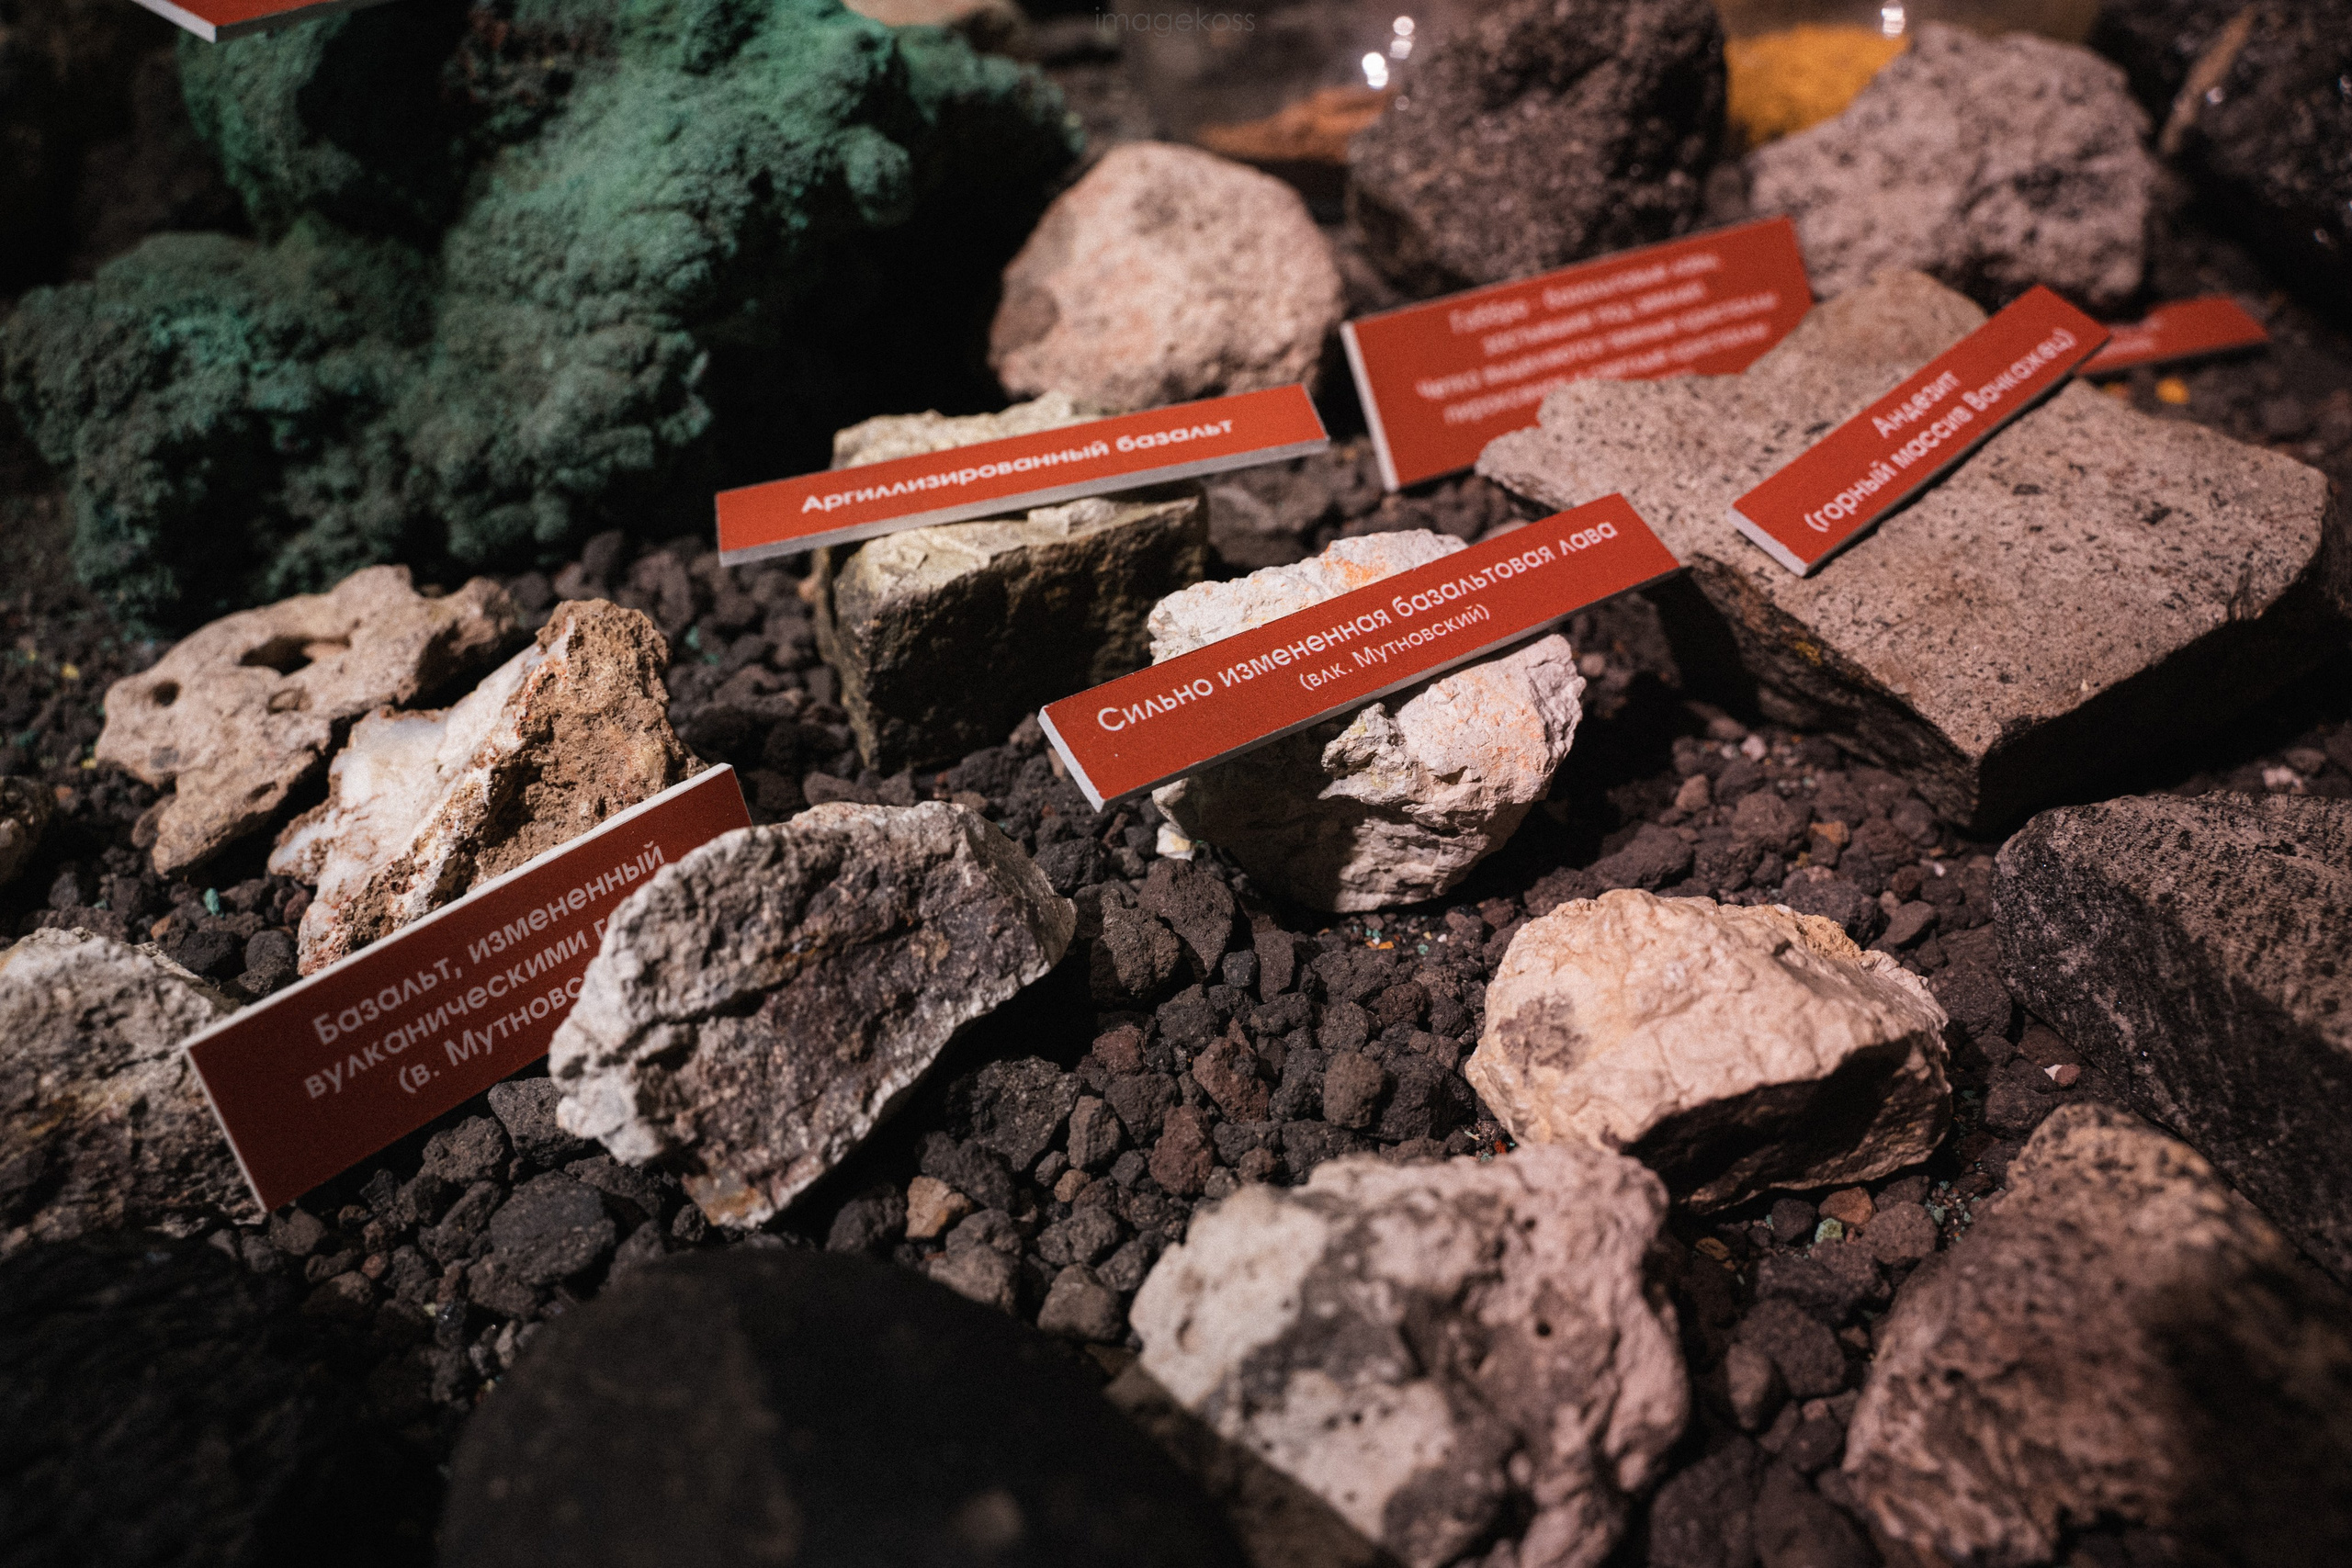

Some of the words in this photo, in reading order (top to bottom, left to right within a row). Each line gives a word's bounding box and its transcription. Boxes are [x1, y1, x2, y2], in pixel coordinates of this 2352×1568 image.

[1871, 370, 1959, 438] Андезит
[801, 440, 1110, 513] Аргиллизированный
[1115, 420, 1232, 452] базальт
[1804, 460, 1897, 533] (горный
[1890, 406, 1973, 468] массив
[1097, 678, 1214, 732] Сильно
[1217, 608, 1392, 688] измененная
[1391, 545, 1555, 618] базальтовая
[1558, 521, 1618, 556] лава
[1298, 662, 1353, 692] (влк.
[1351, 604, 1491, 668] Мутновский)
[312, 957, 463, 1045] Базальт,
[468, 839, 667, 964] измененный
[305, 929, 590, 1098] вулканическими
[397, 1062, 441, 1095] (в.
[445, 973, 583, 1065] Мутновс
